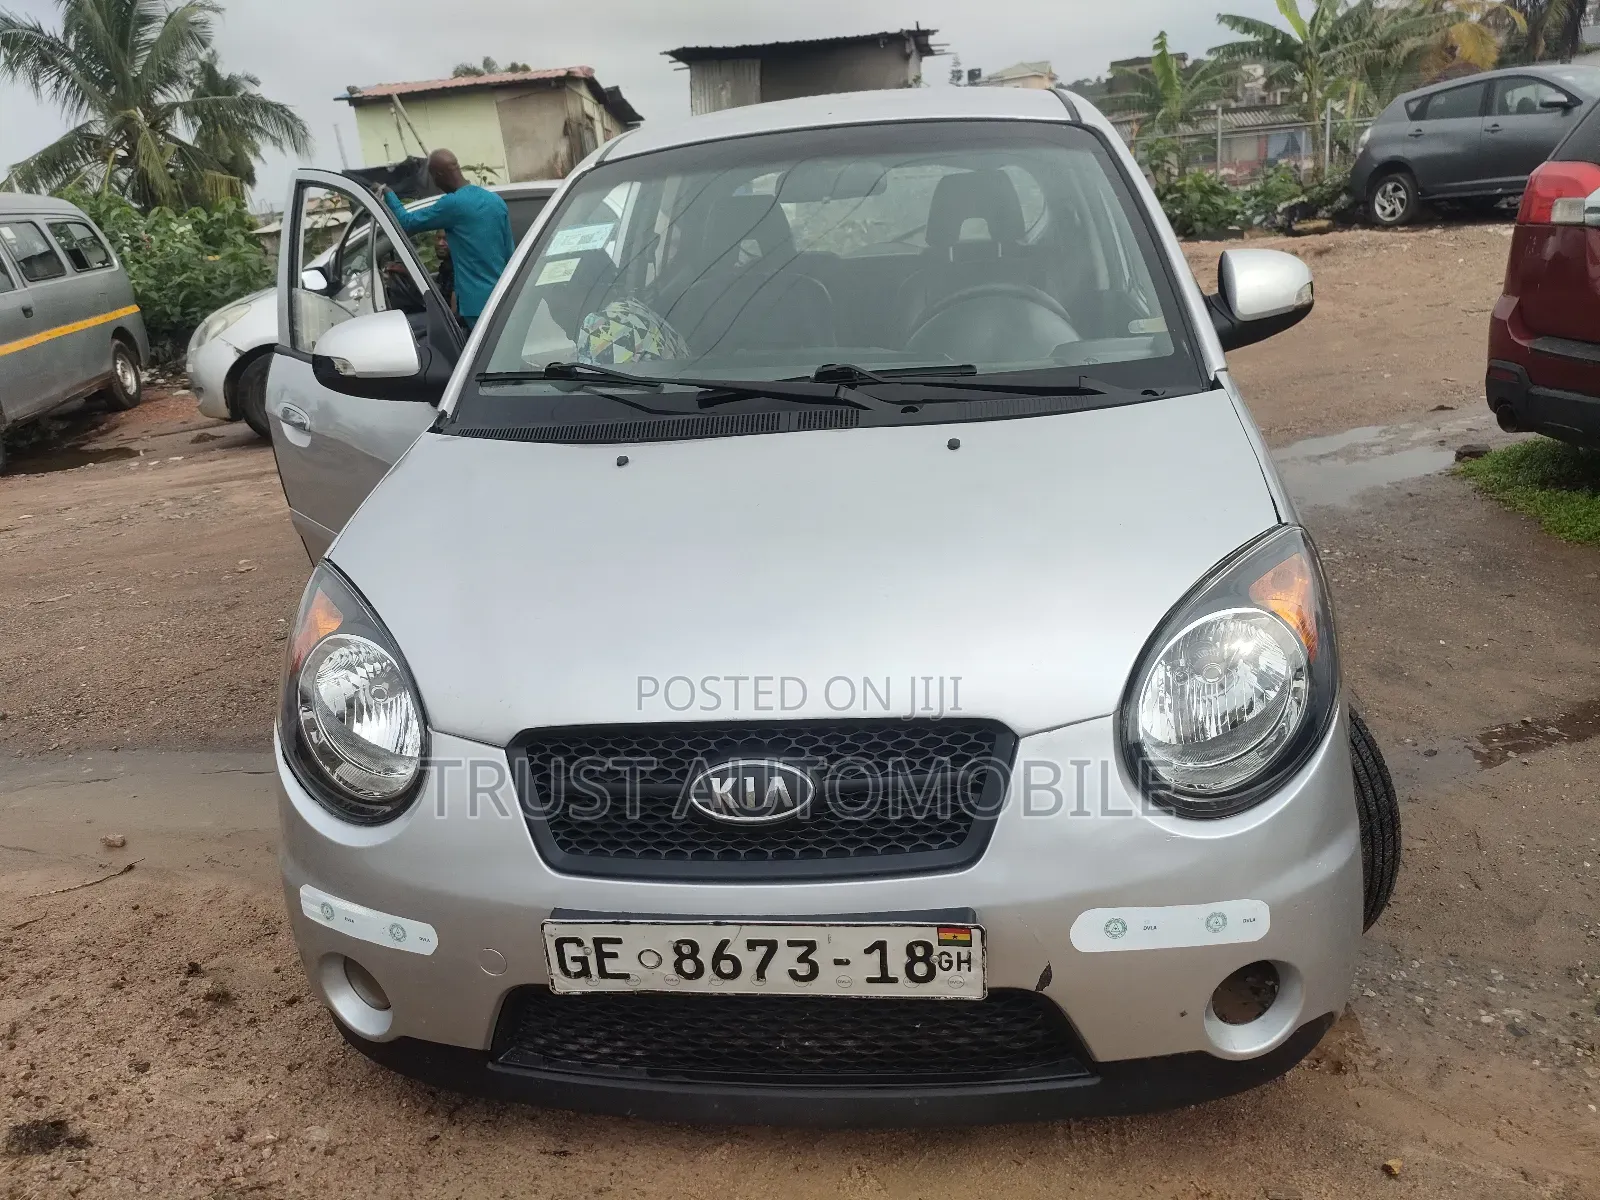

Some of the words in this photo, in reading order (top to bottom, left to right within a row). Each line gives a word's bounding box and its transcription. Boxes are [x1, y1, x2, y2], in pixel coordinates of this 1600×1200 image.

[709, 776, 794, 808] KIA
[554, 936, 631, 980] GE
[937, 950, 972, 973] GH
